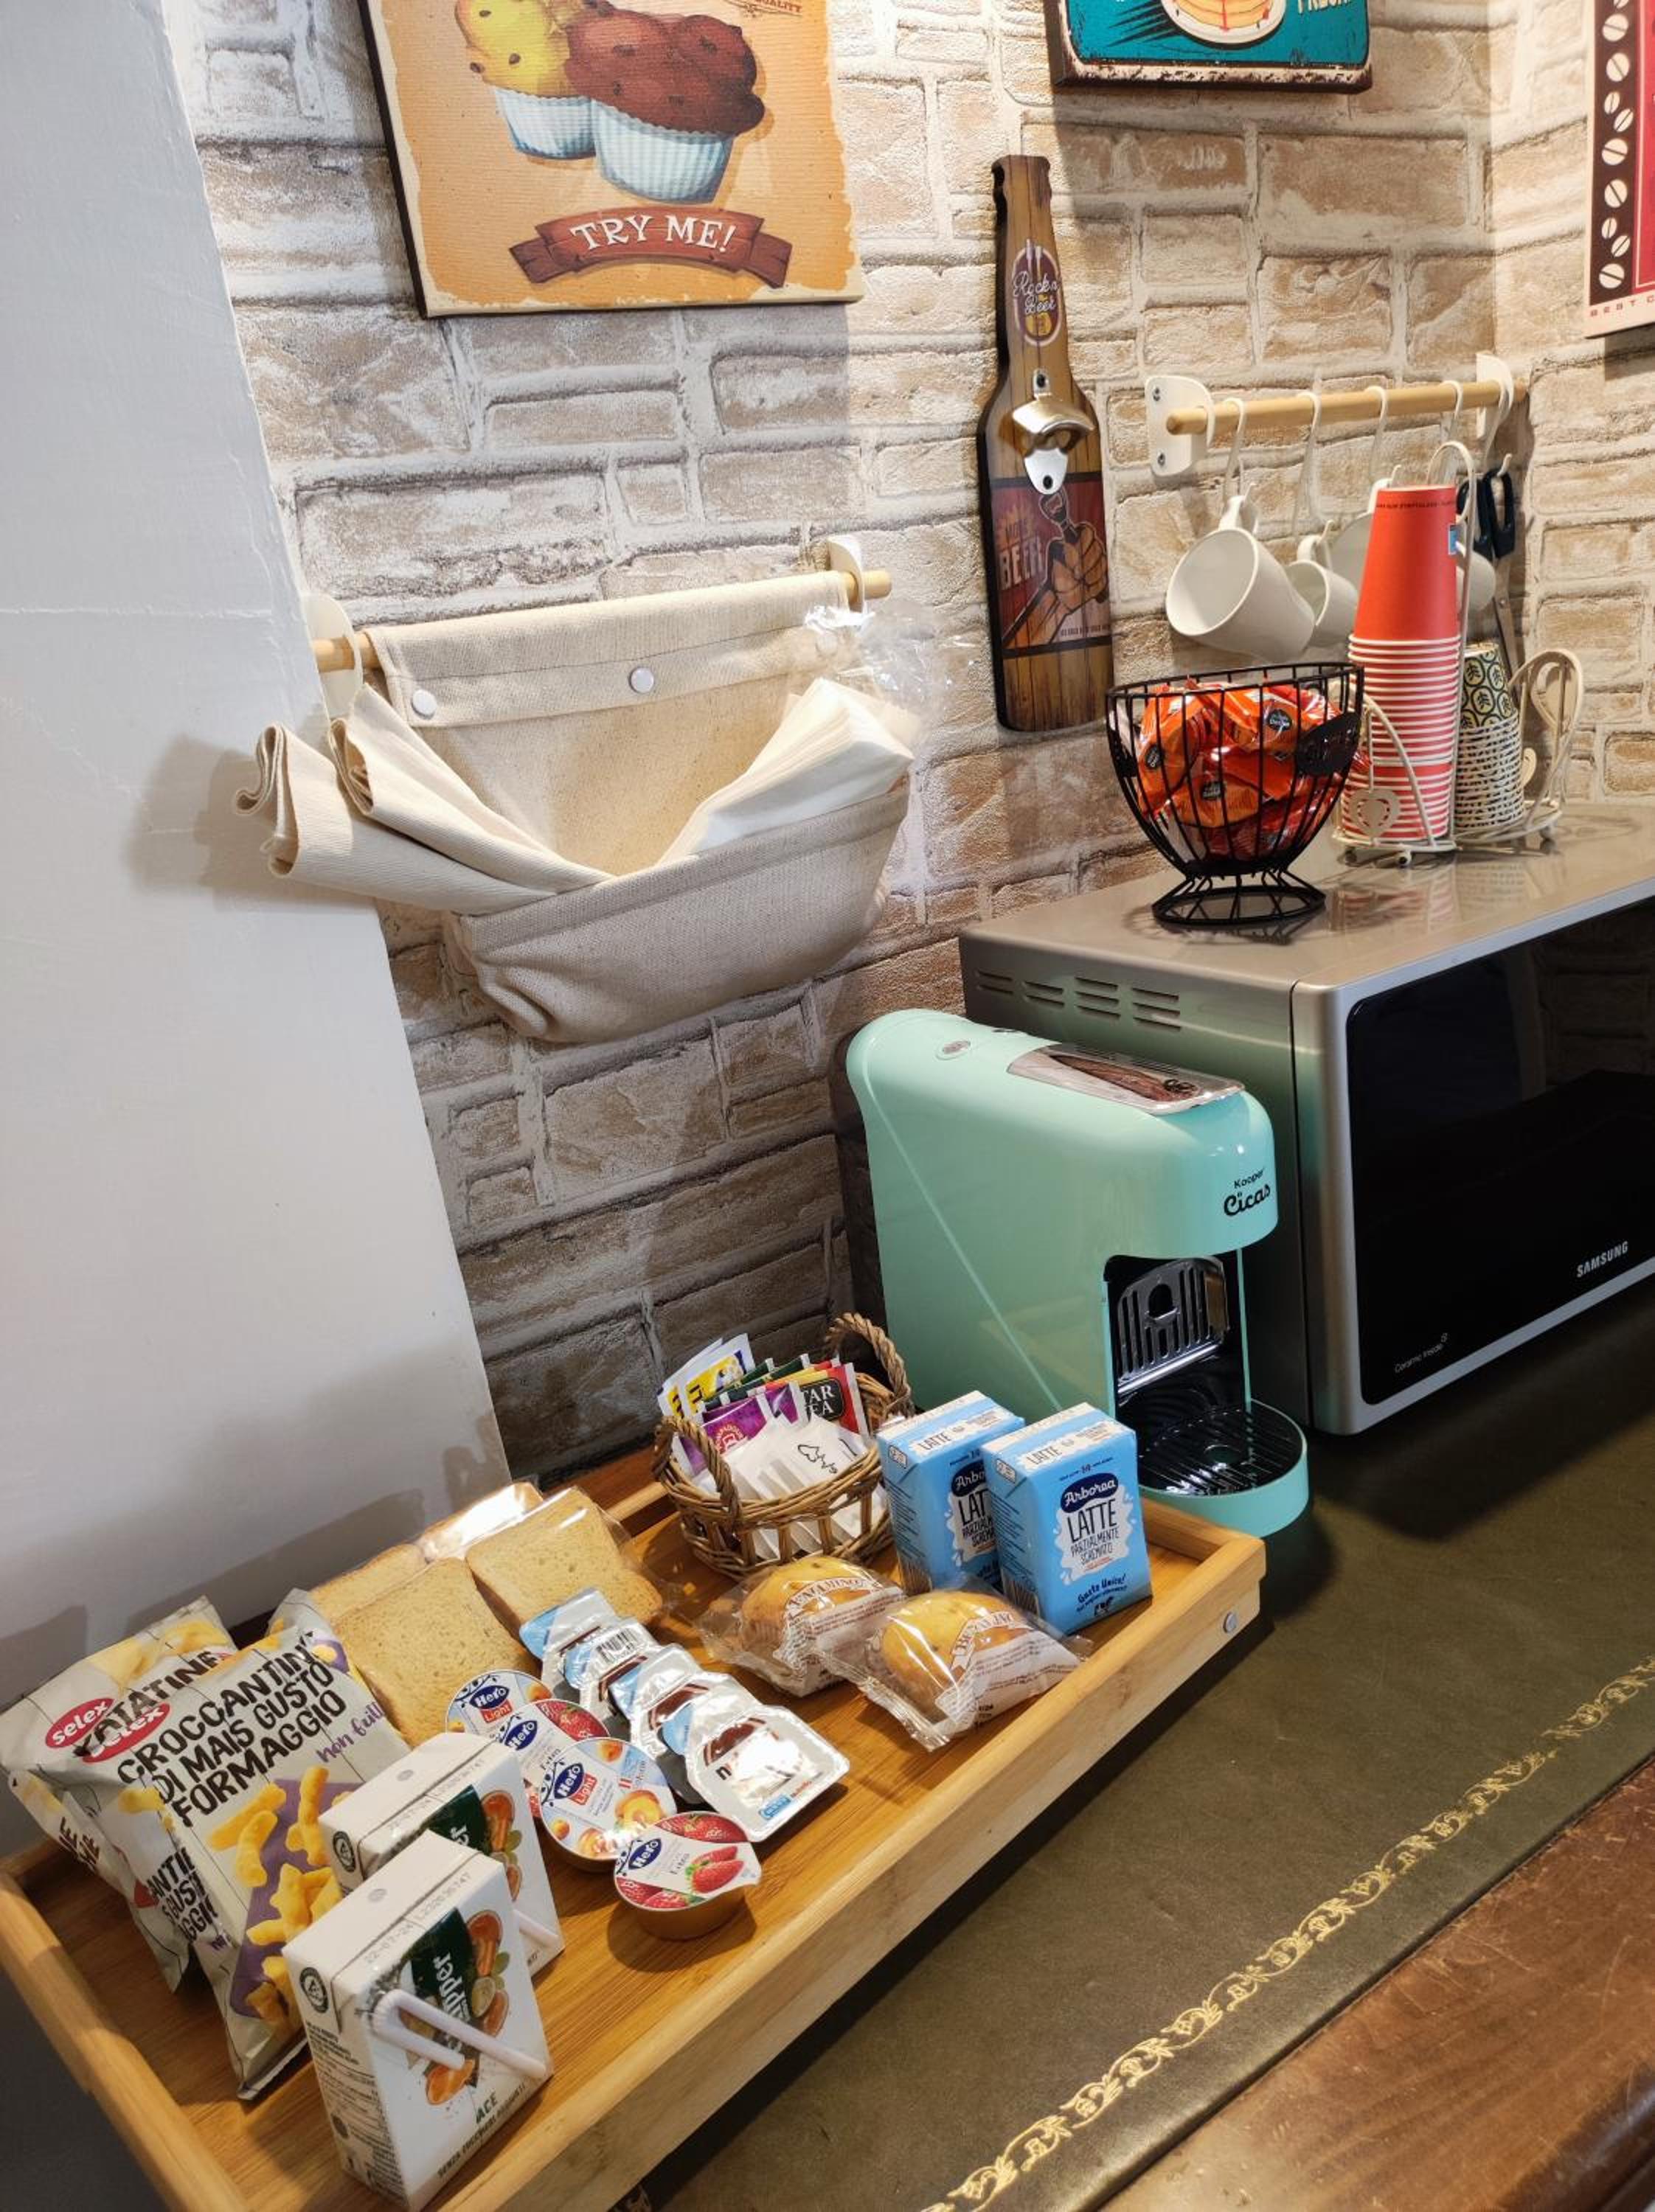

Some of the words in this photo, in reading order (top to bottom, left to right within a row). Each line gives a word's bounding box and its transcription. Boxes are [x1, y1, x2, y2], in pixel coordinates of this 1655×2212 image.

[570, 215, 653, 251] TRY
[665, 214, 738, 254] ME!
[999, 536, 1044, 590] BEER
[1576, 1241, 1628, 1278] SAMSUNG
[802, 1385, 835, 1402] TAR
[805, 1401, 834, 1417] EA
[920, 1433, 951, 1451] LATTE
[1026, 1446, 1062, 1467] LATTE
[955, 1470, 985, 1491] Arbo
[958, 1488, 989, 1526] LAT
[1067, 1498, 1117, 1543] LATTE
[1070, 1526, 1120, 1557] PARZIALMENTE
[473, 1687, 507, 1707] Hero
[484, 1703, 511, 1722] Light
[51, 1700, 110, 1746] selex
[151, 1763, 186, 1804] DI
[184, 1717, 256, 1781] MAIS
[253, 1661, 333, 1731] GUSTO
[507, 1722, 535, 1747] Hero
[173, 1688, 347, 1828] FORMAGGIO
[316, 1733, 355, 1763] non
[557, 1764, 582, 1799] Hero
[574, 1773, 595, 1804] Light
[632, 1839, 659, 1868] Hero
[476, 2091, 498, 2124] ACE
